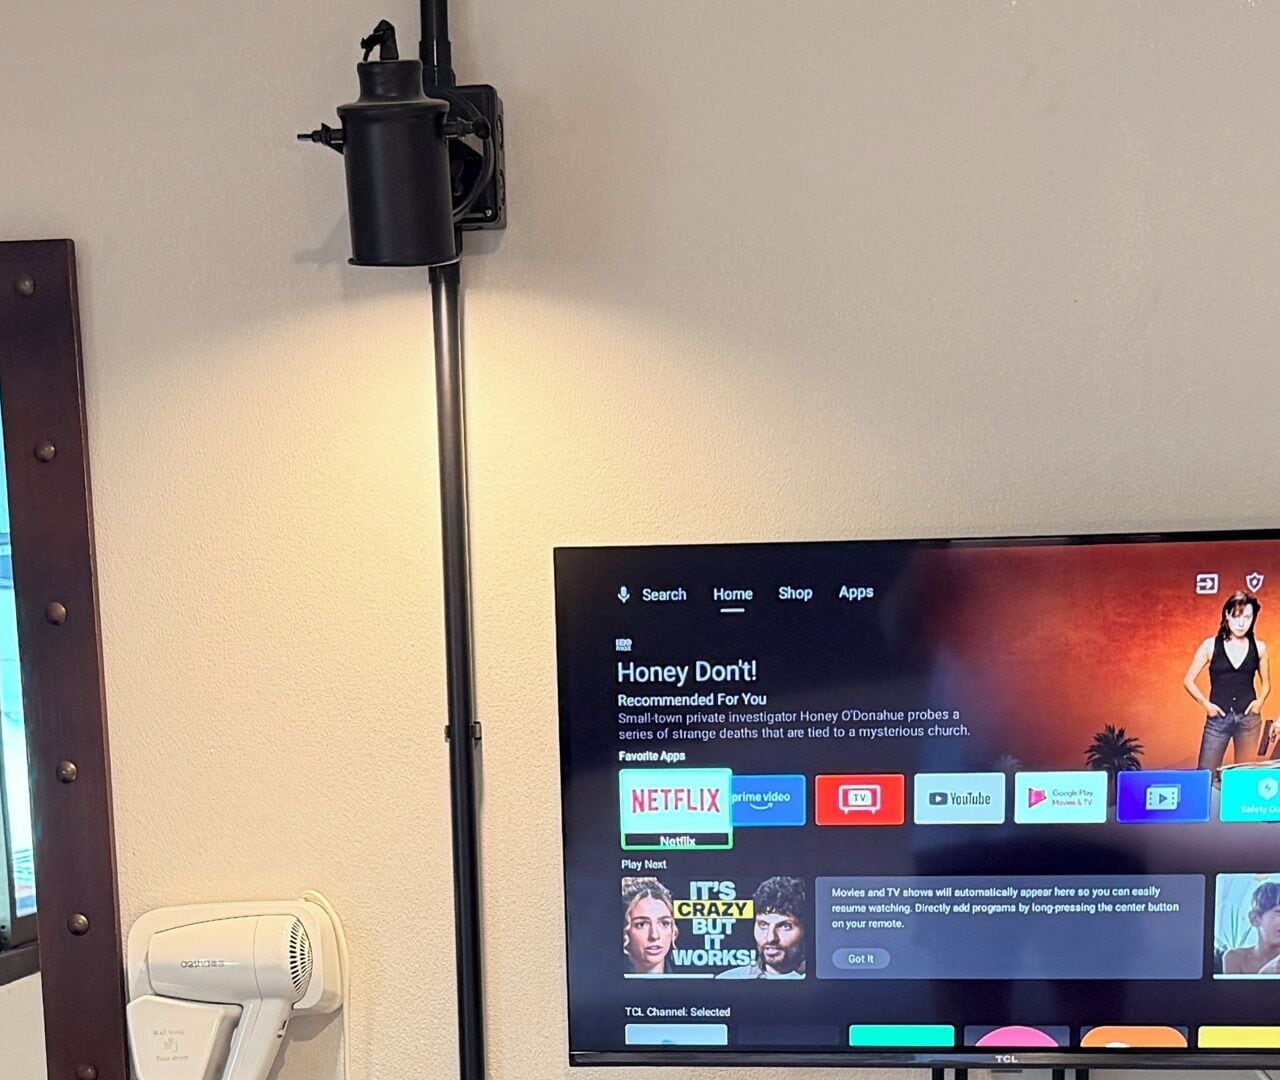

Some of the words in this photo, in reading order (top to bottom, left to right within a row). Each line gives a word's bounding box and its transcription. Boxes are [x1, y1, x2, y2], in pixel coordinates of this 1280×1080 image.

[642, 587, 687, 601] Search
[713, 587, 753, 600] Home
[778, 586, 813, 602] Shop
[839, 585, 874, 602] Apps
[617, 661, 689, 688] Honey
[695, 658, 757, 682] Don't!
[617, 692, 714, 707] Recommended
[717, 692, 740, 706] For
[741, 692, 767, 706] You
[618, 712, 683, 724] Small-town
[686, 712, 726, 725] private
[728, 711, 797, 725] investigator
[800, 710, 838, 724] Honey
[841, 709, 905, 721] O'Donahue
[907, 708, 949, 723] probes
[952, 710, 960, 720] a
[618, 728, 654, 740] series
[656, 727, 669, 739] of
[672, 728, 716, 742] strange
[719, 727, 759, 739] deaths
[761, 727, 784, 739] that
[787, 727, 805, 738] are
[807, 726, 830, 738] tied
[833, 726, 845, 738] to
[848, 728, 856, 737] a
[858, 725, 925, 740] mysterious
[927, 724, 971, 737] church.
[618, 750, 659, 762] Favorite
[660, 750, 686, 763] Apps
[631, 788, 721, 814] NETFLIX
[732, 791, 763, 804] prime
[763, 790, 791, 802] video
[853, 793, 867, 802] TV
[950, 791, 991, 806] YouTube
[660, 835, 697, 847] Netflix
[621, 859, 643, 872] Play
[644, 859, 667, 870] Next
[689, 880, 737, 901] IT'S
[831, 887, 866, 898] Movies
[867, 887, 886, 898] and
[886, 887, 901, 898] TV
[902, 887, 934, 897] shows
[935, 887, 952, 897] will
[954, 886, 1019, 899] automatically
[1020, 887, 1053, 898] appear
[1054, 886, 1076, 897] here
[1077, 888, 1090, 897] so
[1091, 887, 1110, 898] you
[1111, 888, 1130, 897] can
[1131, 886, 1161, 898] easily
[677, 901, 748, 917] CRAZY
[831, 904, 867, 913] resume
[868, 903, 913, 915] watching.
[914, 903, 951, 914] Directly
[952, 903, 971, 913] add
[971, 903, 1017, 915] programs
[1018, 902, 1030, 914] by
[1031, 902, 1096, 914] long-pressing
[1097, 902, 1114, 912] the
[1114, 902, 1146, 912] center
[1147, 901, 1180, 912] button
[692, 917, 737, 935] BUT
[831, 920, 845, 929] on
[845, 919, 867, 930] your
[868, 919, 905, 929] remote.
[704, 934, 726, 950] IT
[672, 949, 757, 967] WORKS!
[847, 953, 866, 964] Got
[624, 1006, 645, 1017] TCL
[646, 1006, 688, 1017] Channel:
[690, 1006, 731, 1017] Selected
[995, 1055, 1019, 1064] TCL
